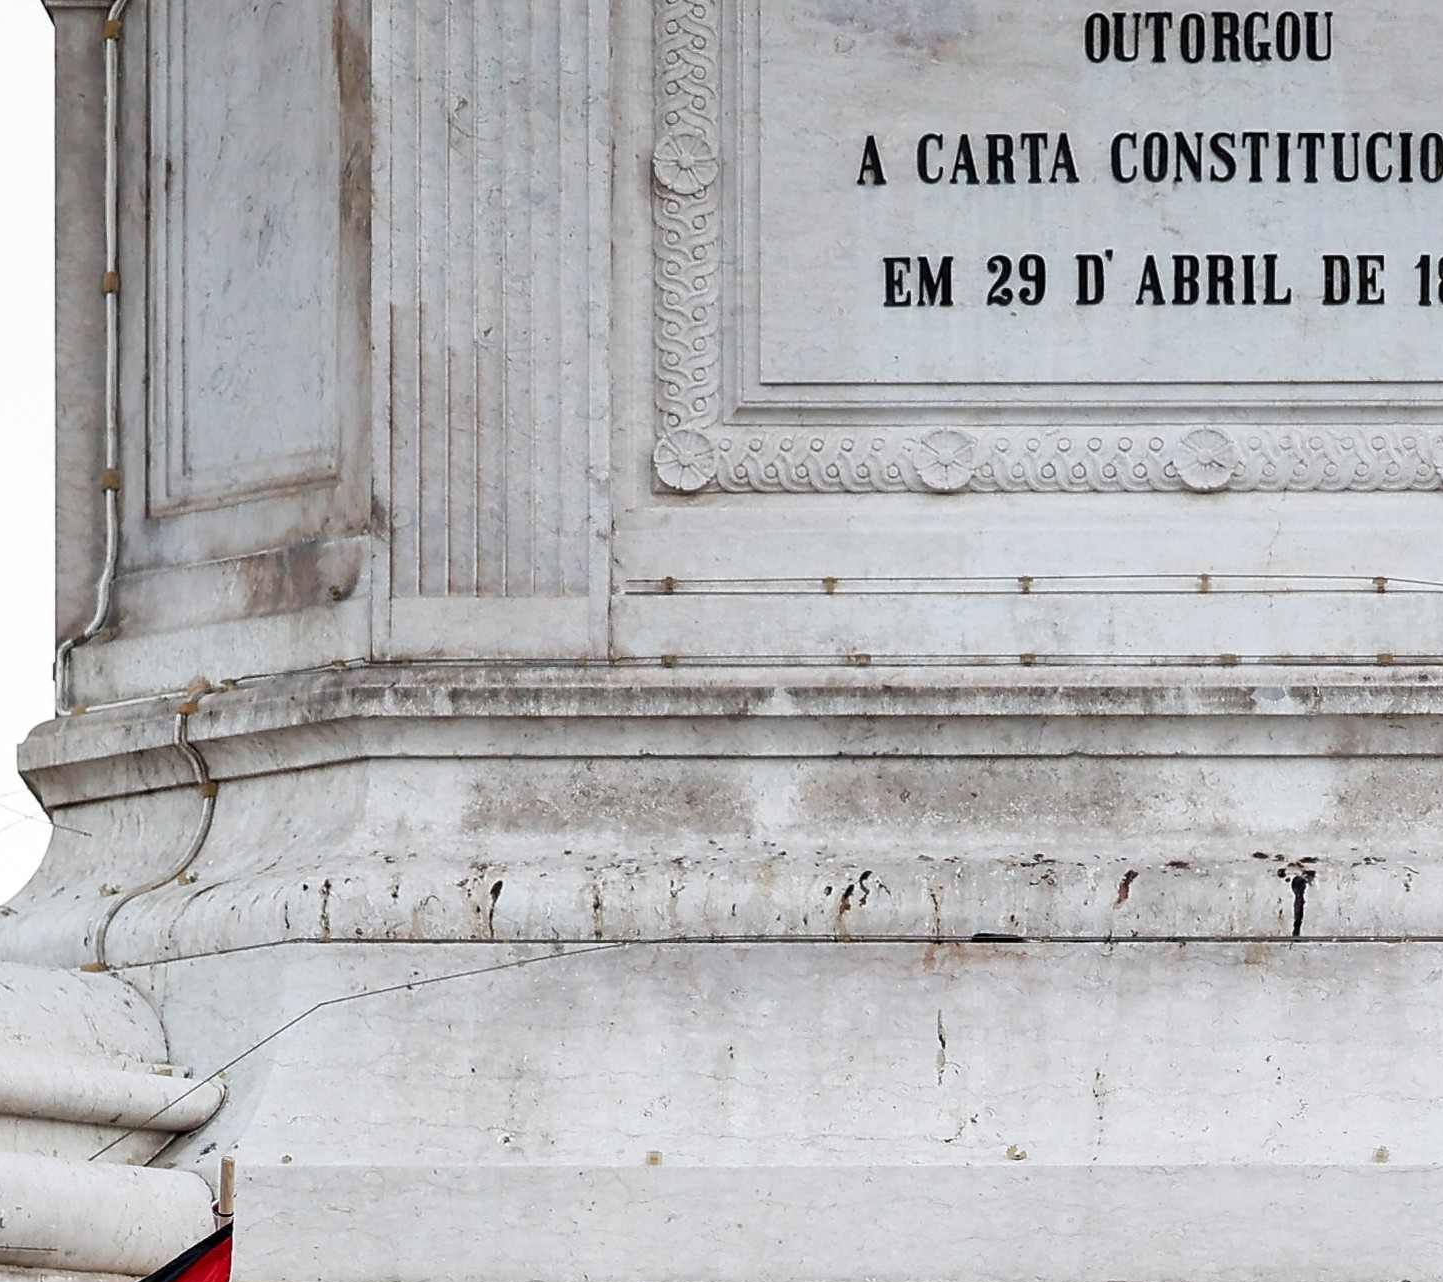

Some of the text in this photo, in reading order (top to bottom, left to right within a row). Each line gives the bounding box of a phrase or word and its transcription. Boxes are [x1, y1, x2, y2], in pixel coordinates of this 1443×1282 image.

[1083, 10, 1335, 65] OUTORGOU
[856, 134, 887, 187] A
[915, 130, 1080, 186] CARTA
[882, 255, 955, 308] EM
[985, 253, 1047, 308] 29
[1136, 253, 1293, 308] ABRIL
[1322, 254, 1386, 308] DE
